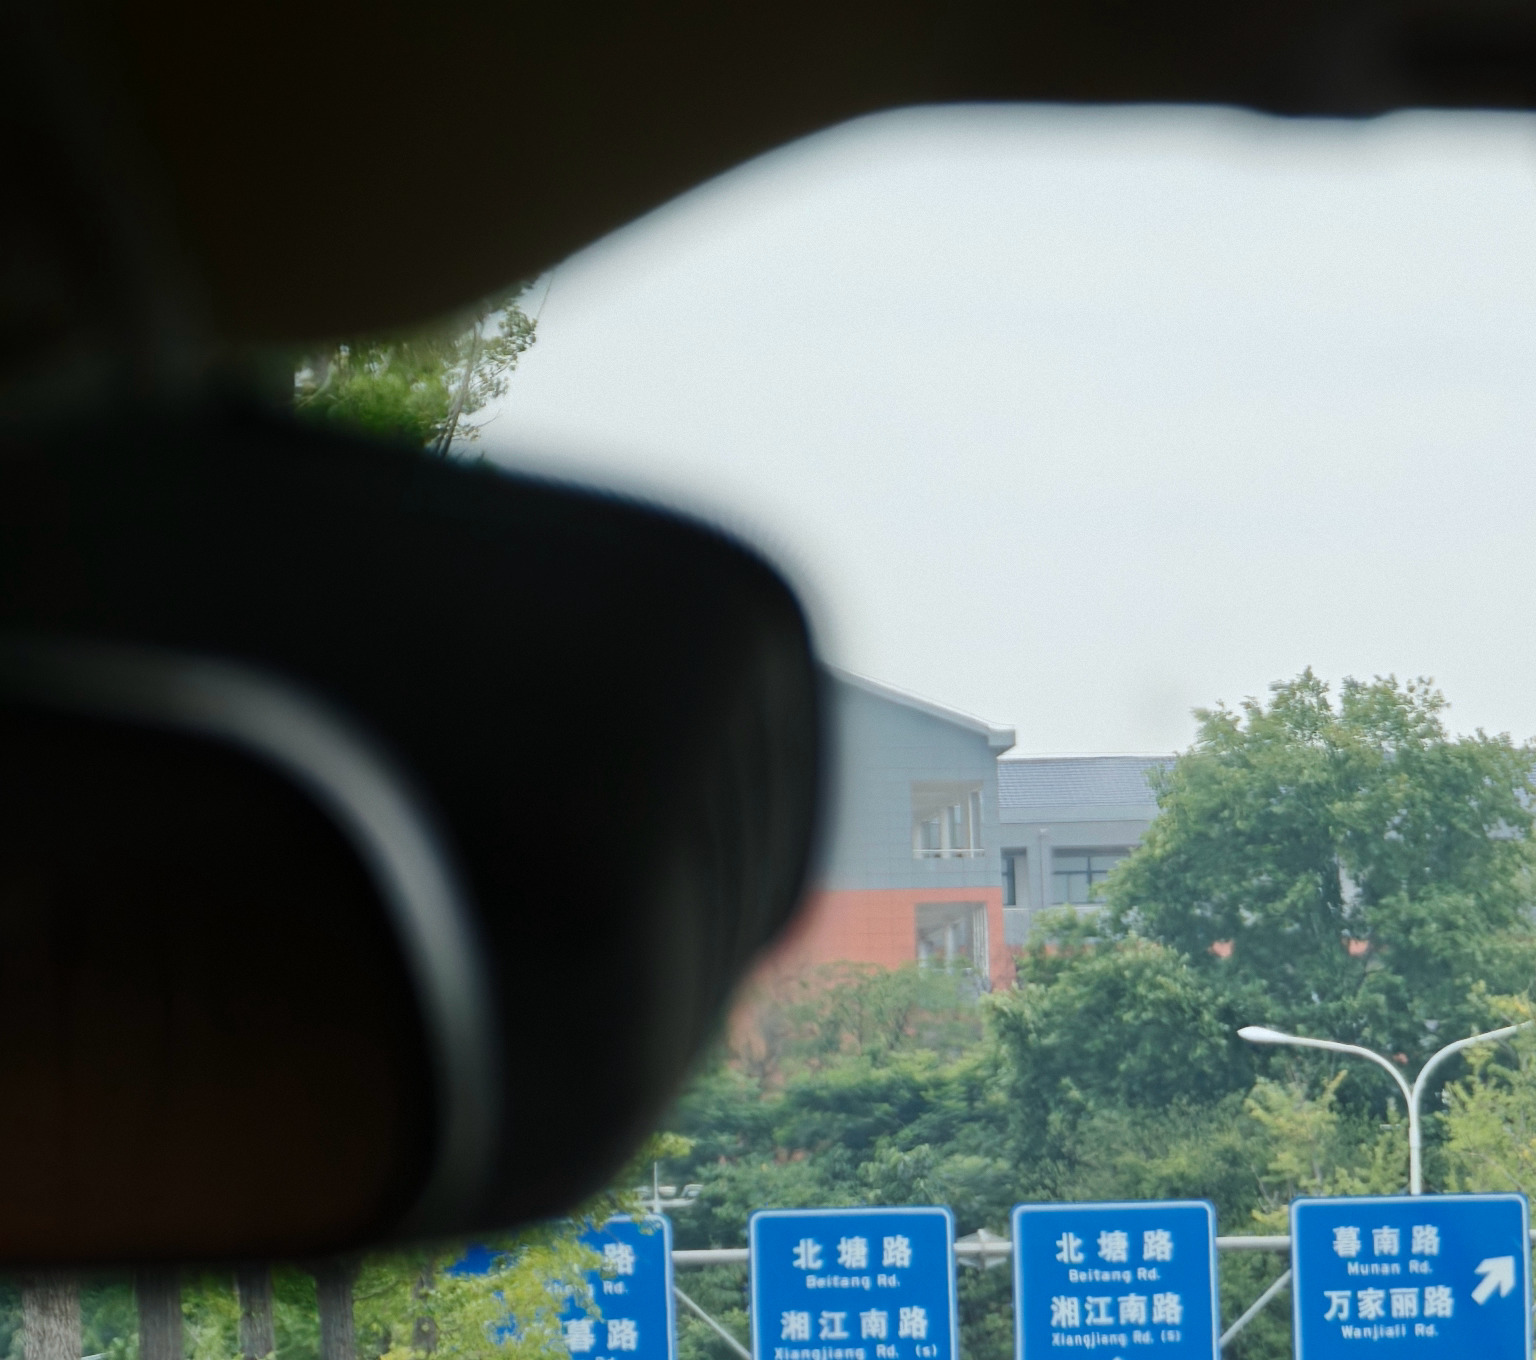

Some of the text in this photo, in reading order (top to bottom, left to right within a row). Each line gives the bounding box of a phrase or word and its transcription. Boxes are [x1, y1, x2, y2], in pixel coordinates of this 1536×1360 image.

[793, 1235, 914, 1270] 北塘路
[1055, 1229, 1174, 1264] 北塘路
[1068, 1267, 1161, 1284] Beitang Rd.
[1347, 1260, 1433, 1275] Munan Rd.
[806, 1273, 901, 1291] Beitang Rd.
[1050, 1292, 1184, 1329] 湘江南路
[1323, 1285, 1454, 1321] 万家丽路
[780, 1305, 929, 1342] 湘江南路
[1341, 1323, 1439, 1341] Wanjiali Rd.
[1051, 1332, 1128, 1349] Xiangjiang
[1132, 1330, 1154, 1345] Rd.
[876, 1344, 899, 1359] Rd.
